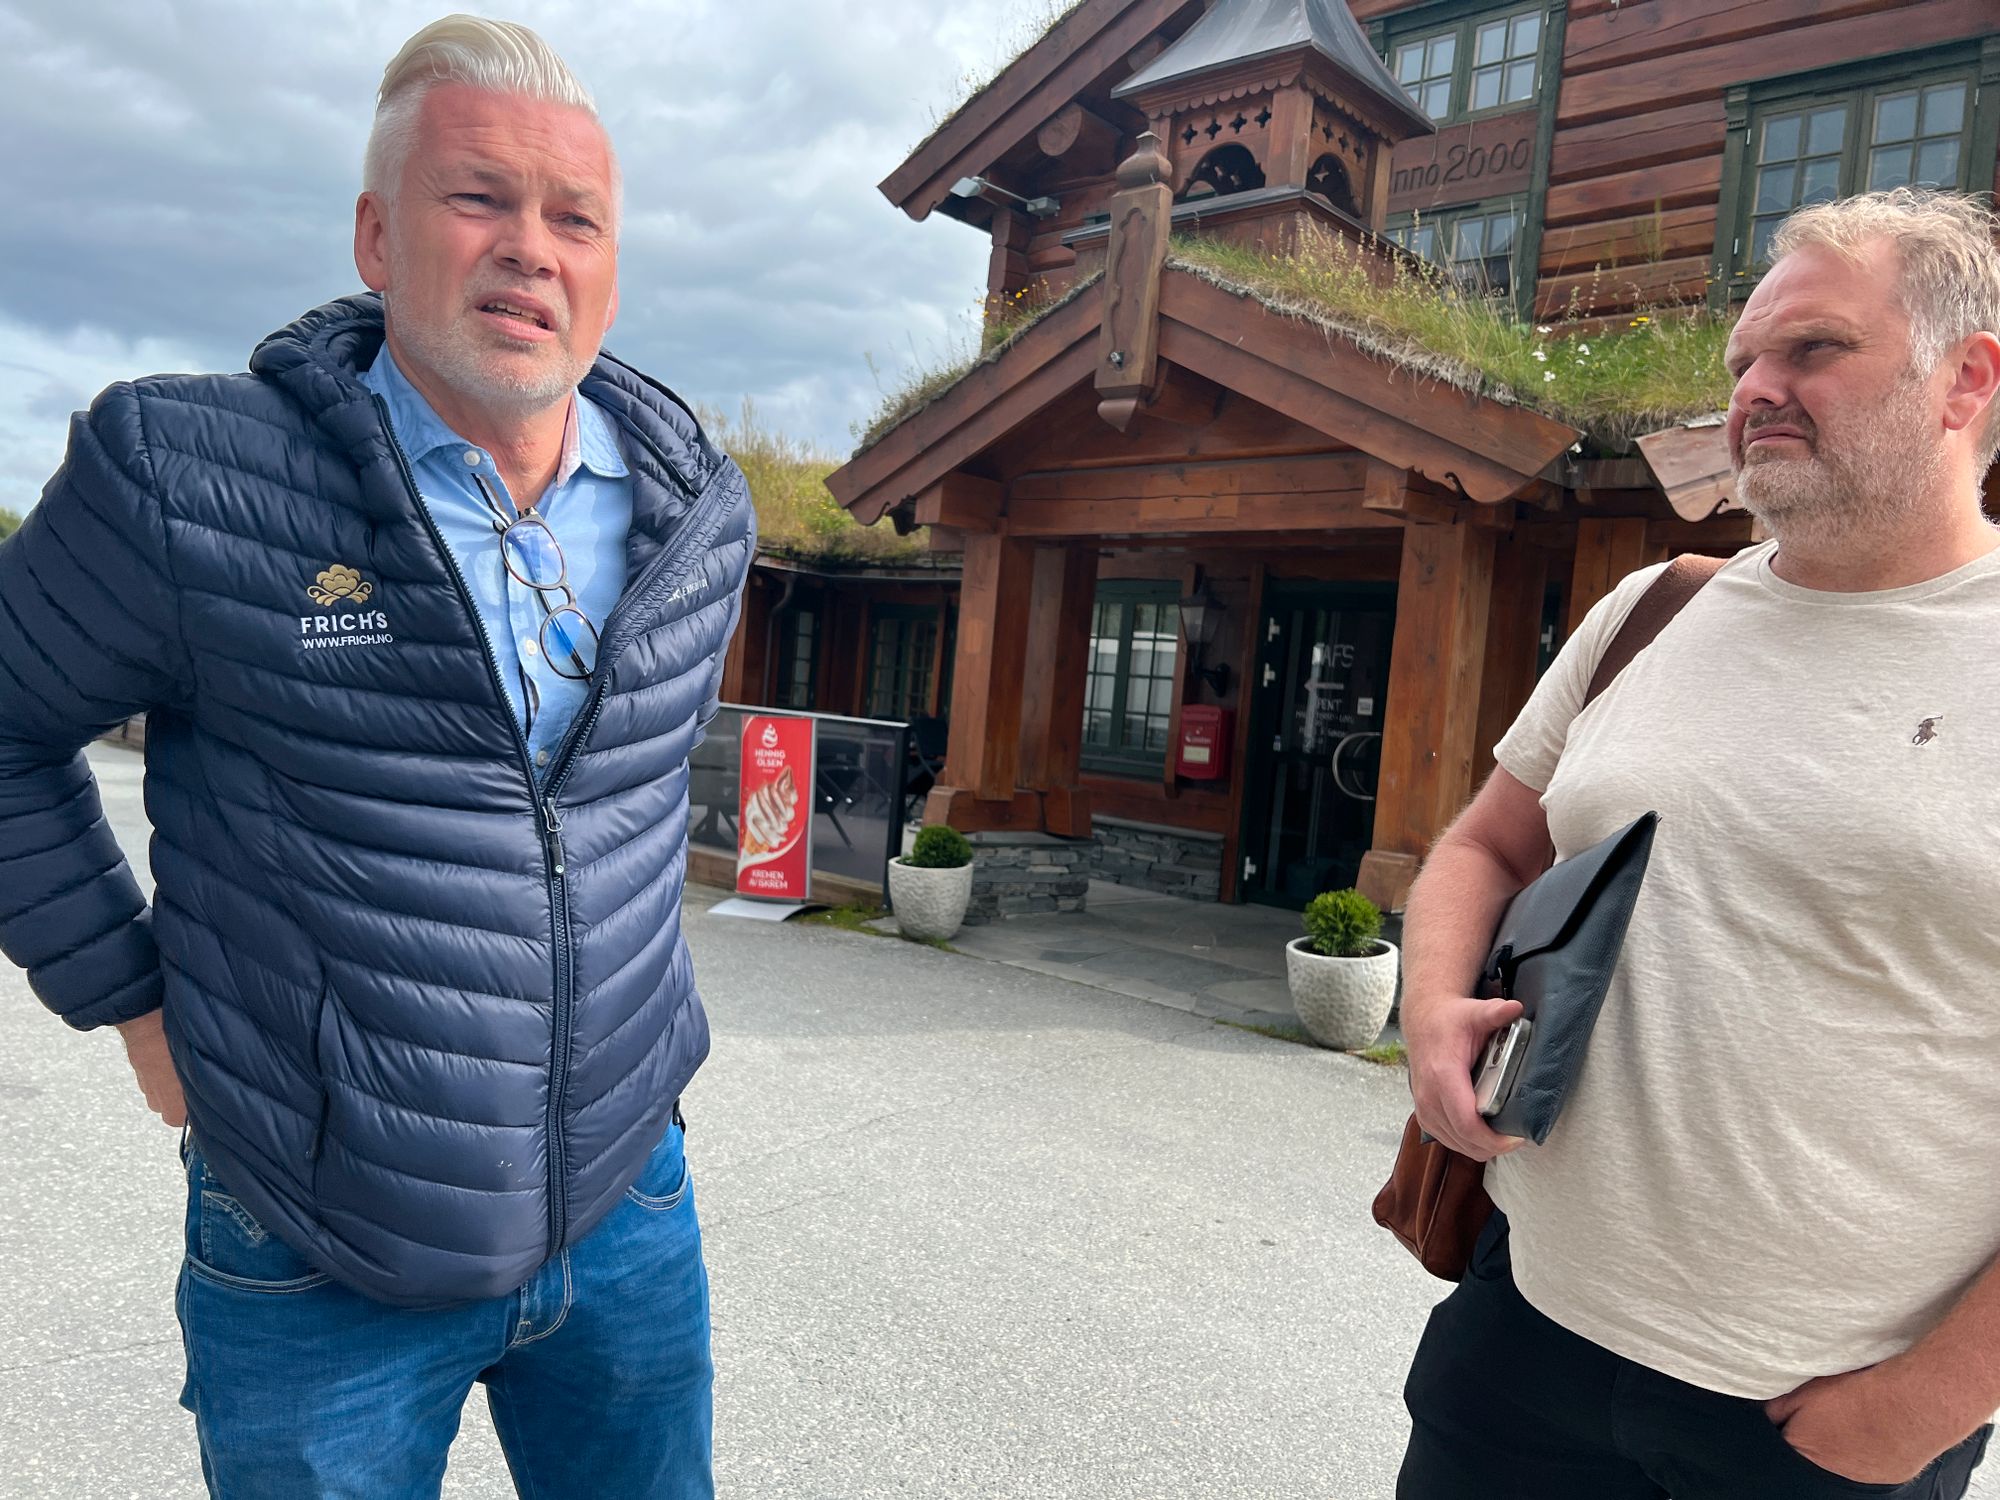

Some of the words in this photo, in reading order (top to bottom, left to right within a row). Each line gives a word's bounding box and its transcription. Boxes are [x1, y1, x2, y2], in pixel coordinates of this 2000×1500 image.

[1391, 157, 1440, 194] nno
[1443, 138, 1529, 183] 2000
[300, 610, 388, 634] FRICH'S
[302, 634, 393, 649] WWW.FRICH.NO
[755, 749, 786, 759] HENNIG
[756, 759, 783, 767] OLSEN
